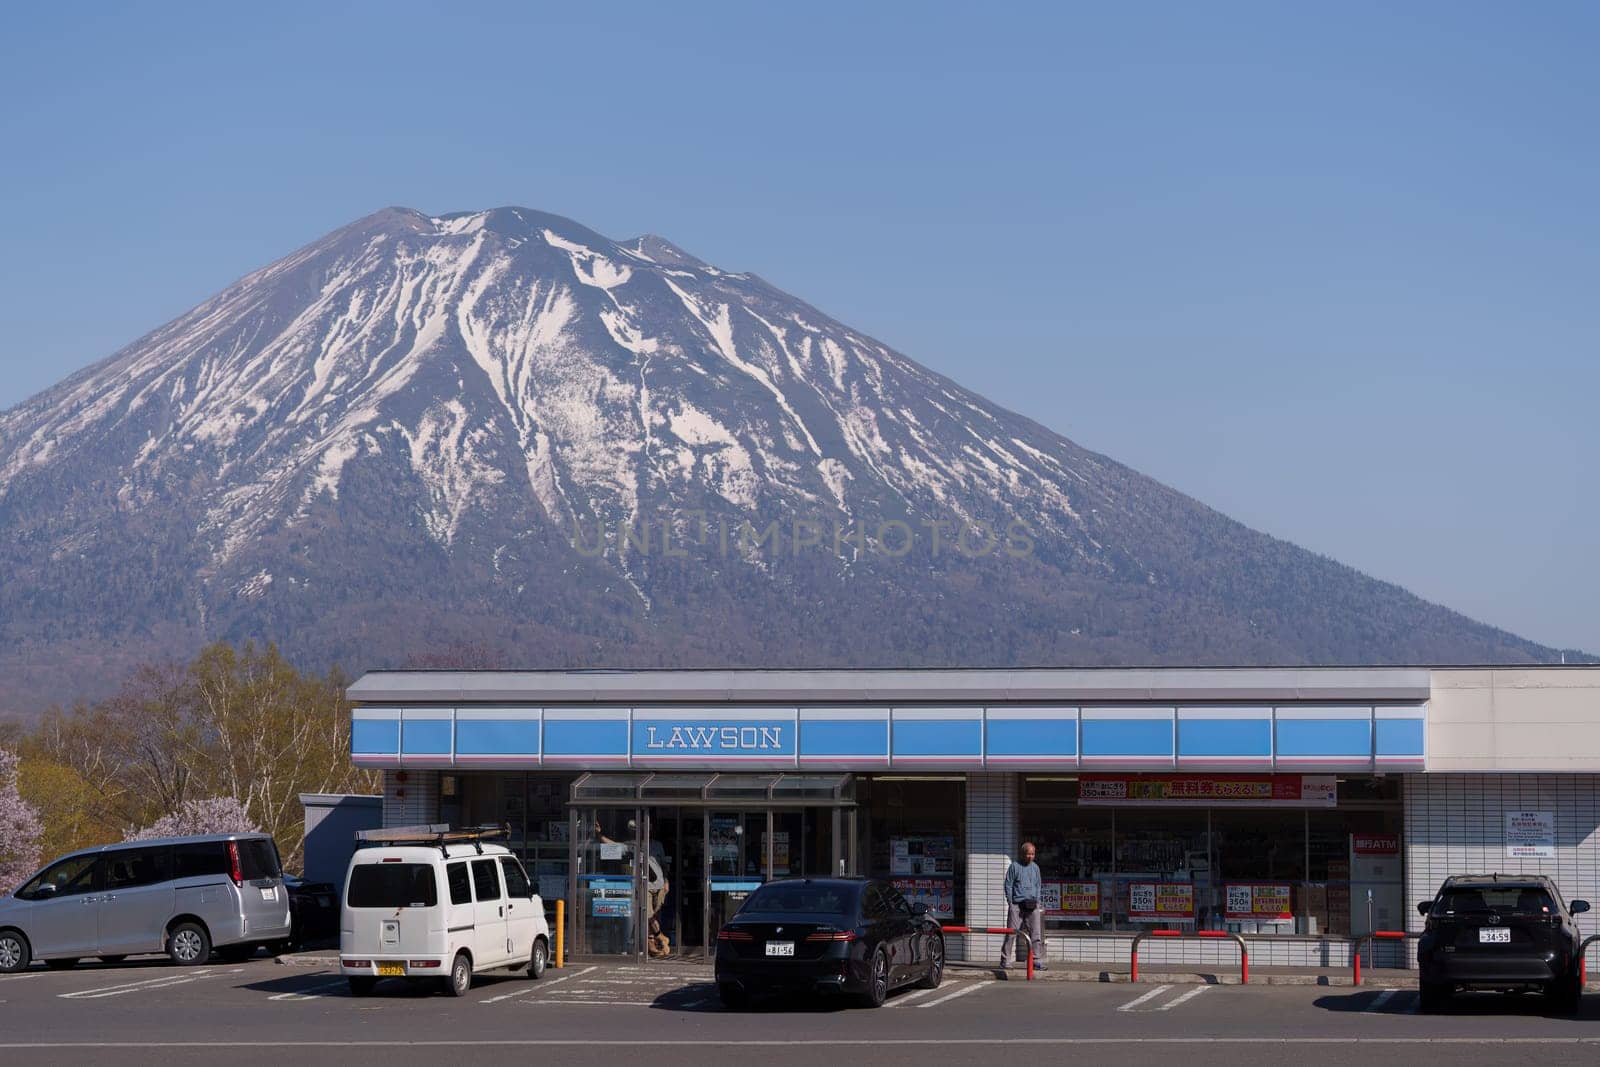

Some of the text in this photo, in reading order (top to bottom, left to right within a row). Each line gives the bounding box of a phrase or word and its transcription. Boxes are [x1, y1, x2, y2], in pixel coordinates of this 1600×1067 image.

[646, 726, 782, 749] LAWSON
[1355, 839, 1397, 849] 銀行ATM
[1486, 933, 1509, 942] 34-59
